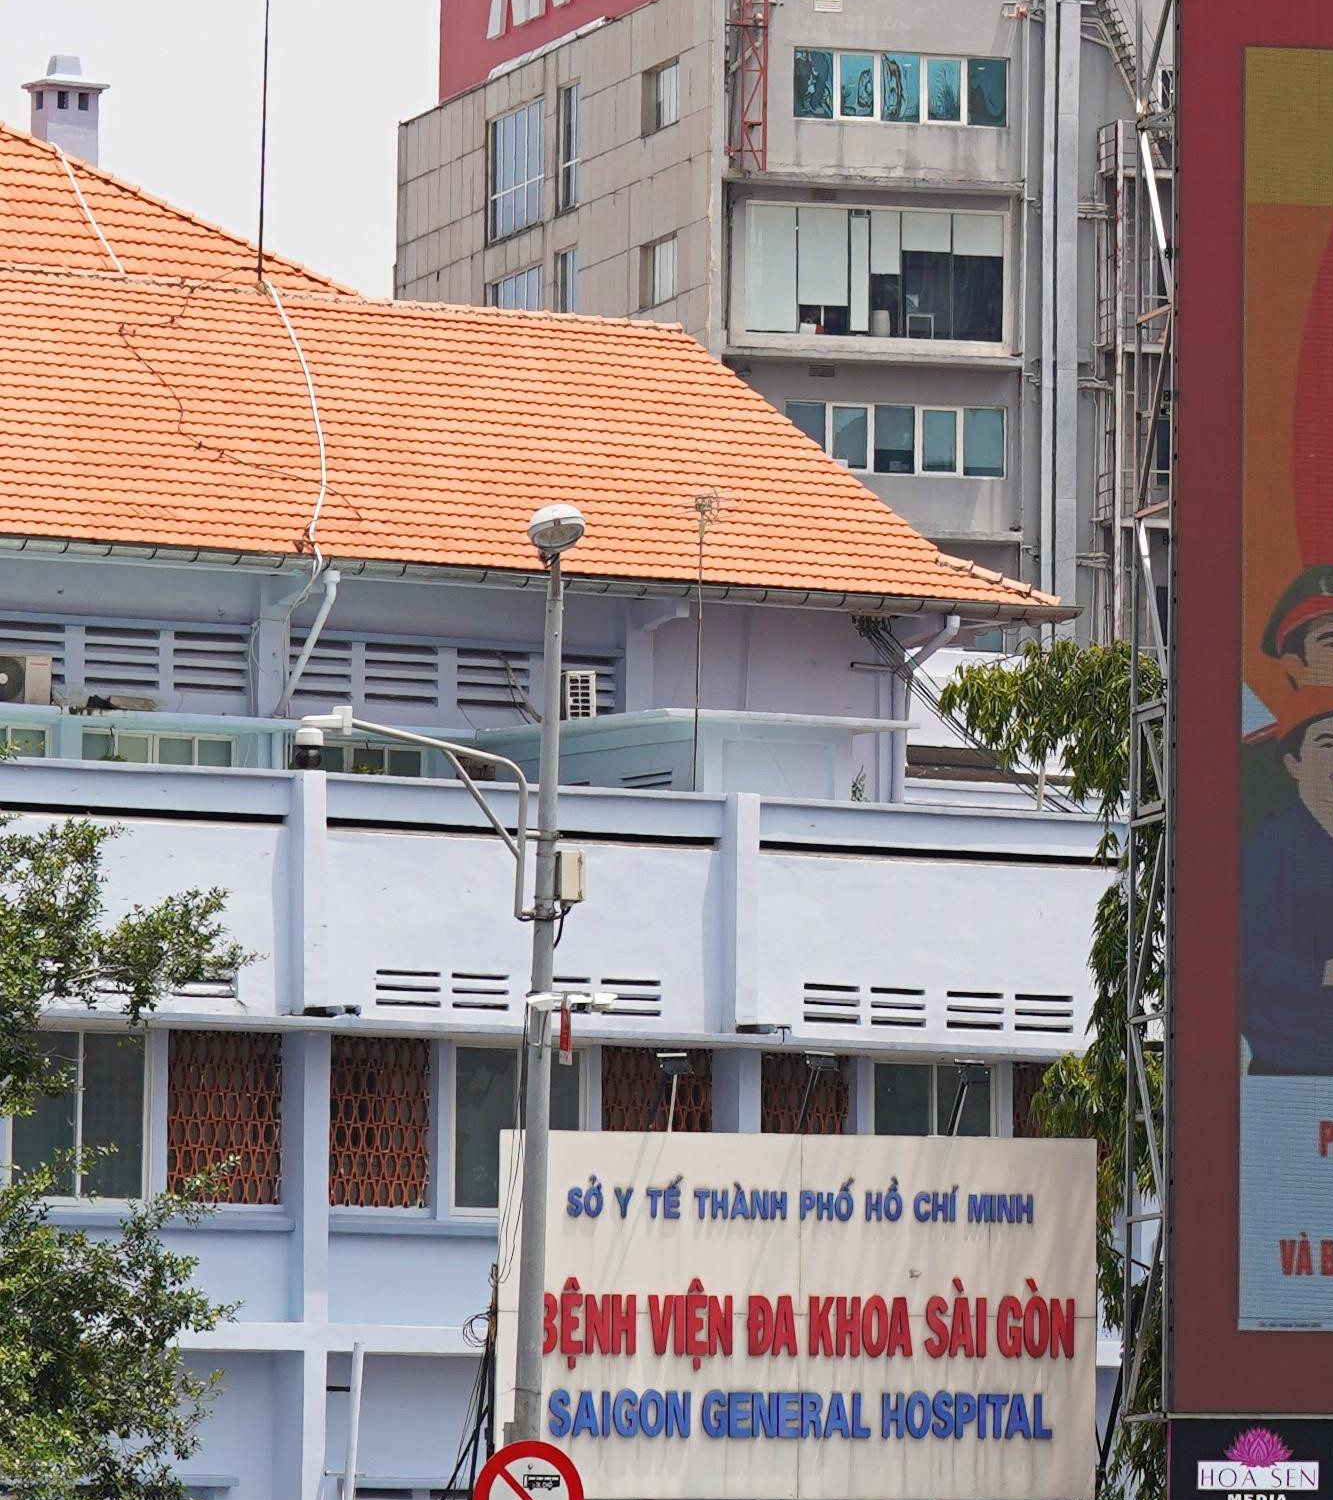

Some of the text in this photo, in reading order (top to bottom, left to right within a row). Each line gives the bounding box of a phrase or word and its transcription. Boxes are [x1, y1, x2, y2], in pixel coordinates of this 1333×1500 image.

[567, 1174, 1034, 1224] SỞ Y TẾ THÀNH PHỐ HỒ CHÍ MINH
[1280, 1231, 1314, 1276] VÀ
[543, 1276, 1075, 1372] BỆNH VIỆN ĐA KHOA SÀI GÒN
[549, 1388, 1053, 1441] SAIGON GENERAL HOSPITAL
[1201, 1467, 1317, 1488] HOA SEN
